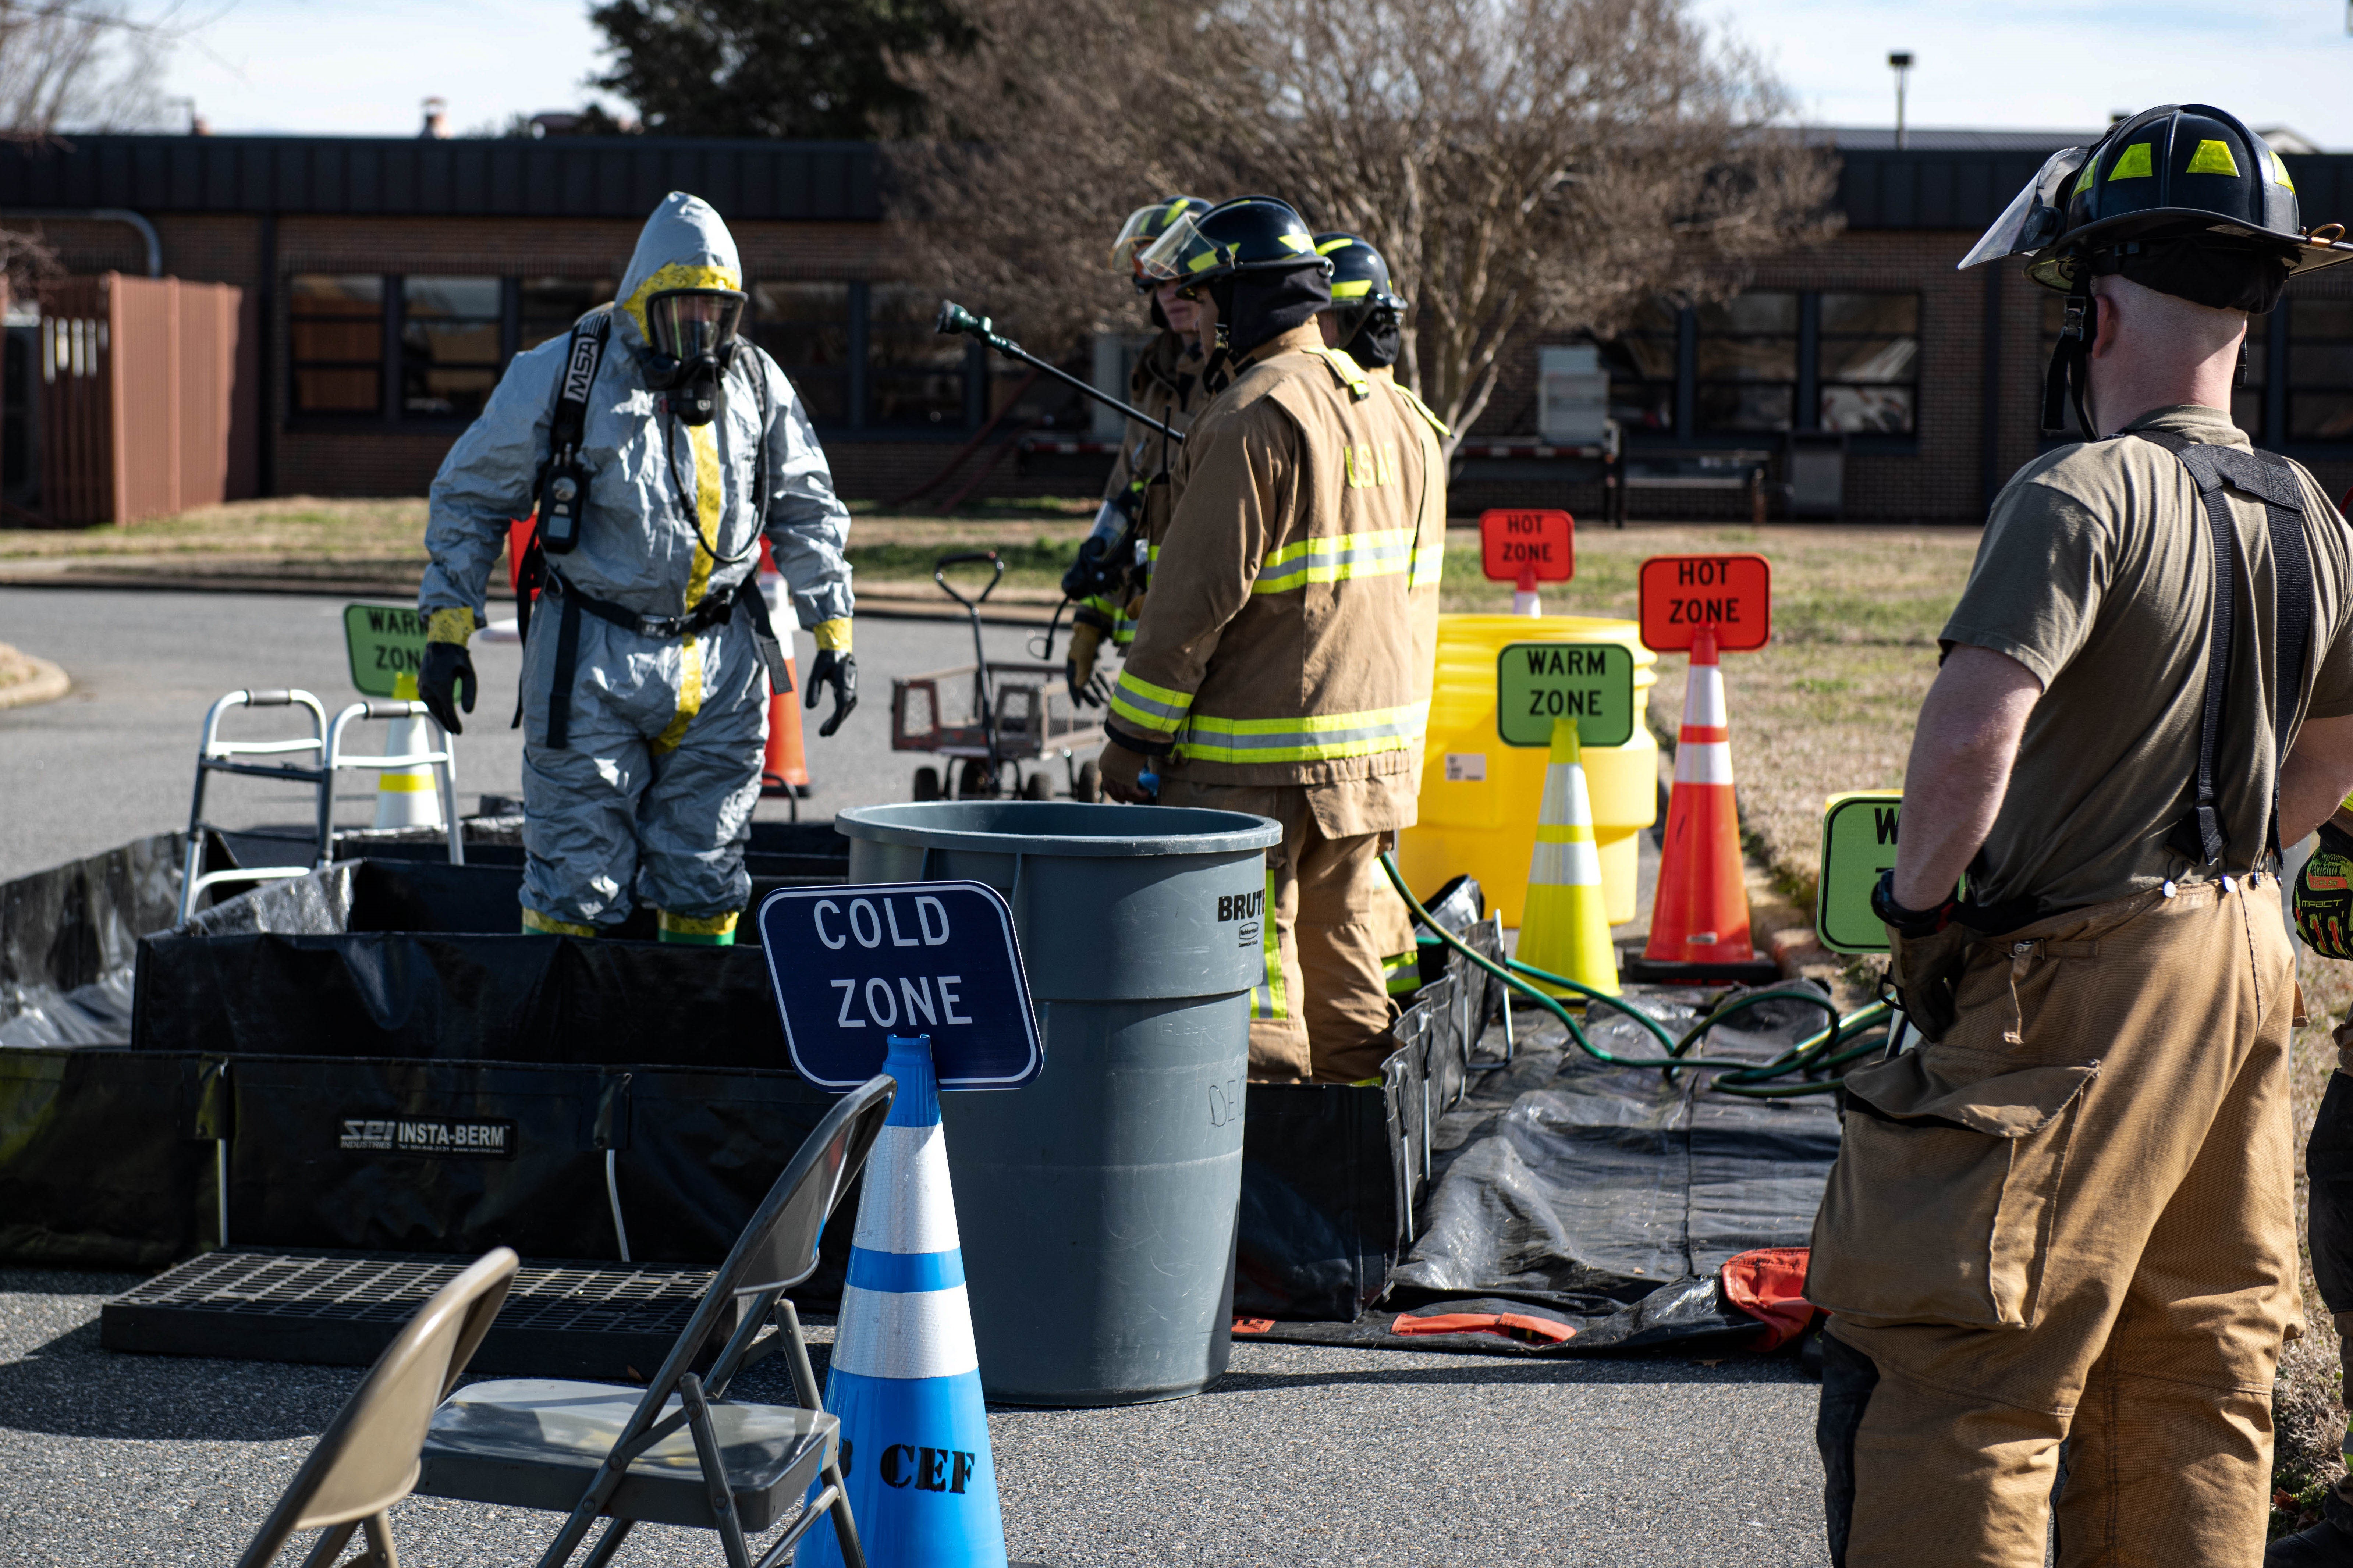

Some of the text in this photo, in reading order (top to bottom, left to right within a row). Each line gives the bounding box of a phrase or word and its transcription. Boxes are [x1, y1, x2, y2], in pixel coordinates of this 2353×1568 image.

[568, 341, 599, 398] MSA
[1344, 442, 1396, 489] USAF
[1508, 515, 1543, 533] HOT
[1503, 543, 1552, 562] ZONE
[1679, 560, 1730, 585] HOT
[1669, 598, 1740, 623] ZONE
[375, 644, 422, 671] ZON
[1527, 650, 1606, 675] WARM
[1529, 690, 1603, 715] ZONE
[814, 896, 950, 950] COLD
[830, 975, 973, 1028] ZONE
[341, 1140, 393, 1149] INDUSTRIES
[398, 1122, 504, 1147] INSTA-BERM
[880, 1444, 975, 1494] CEF
